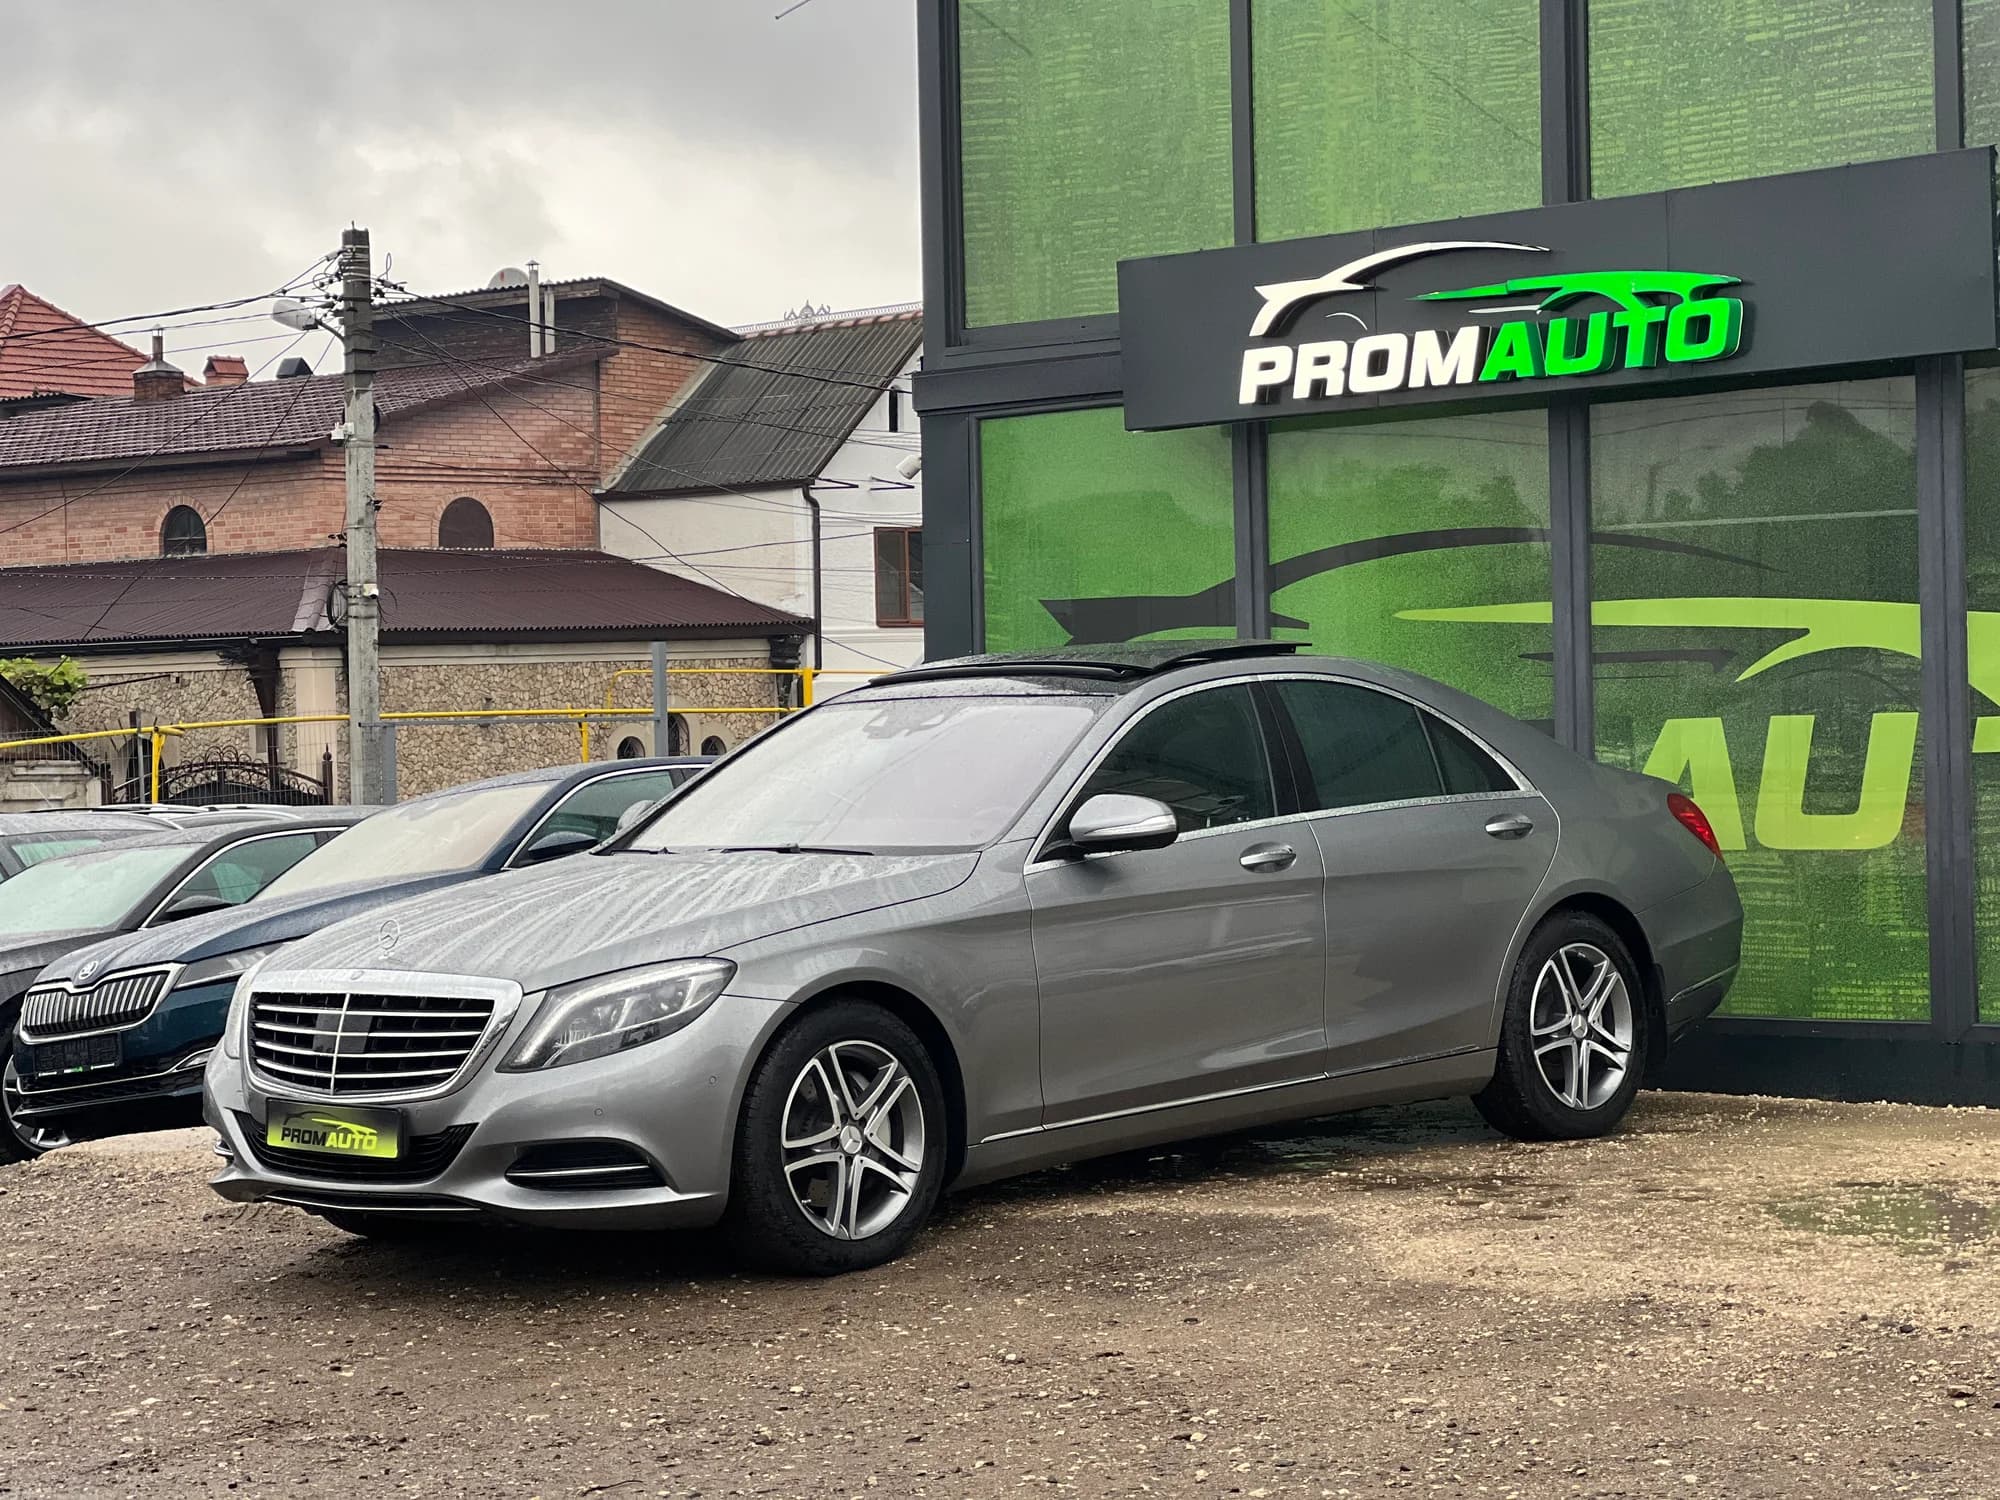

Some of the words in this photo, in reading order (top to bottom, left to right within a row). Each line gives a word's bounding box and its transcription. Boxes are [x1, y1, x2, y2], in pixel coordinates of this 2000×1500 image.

[1239, 298, 1742, 404] PROMAUTO
[1642, 712, 2000, 851] AU
[281, 1127, 378, 1150] PROMAUTO
